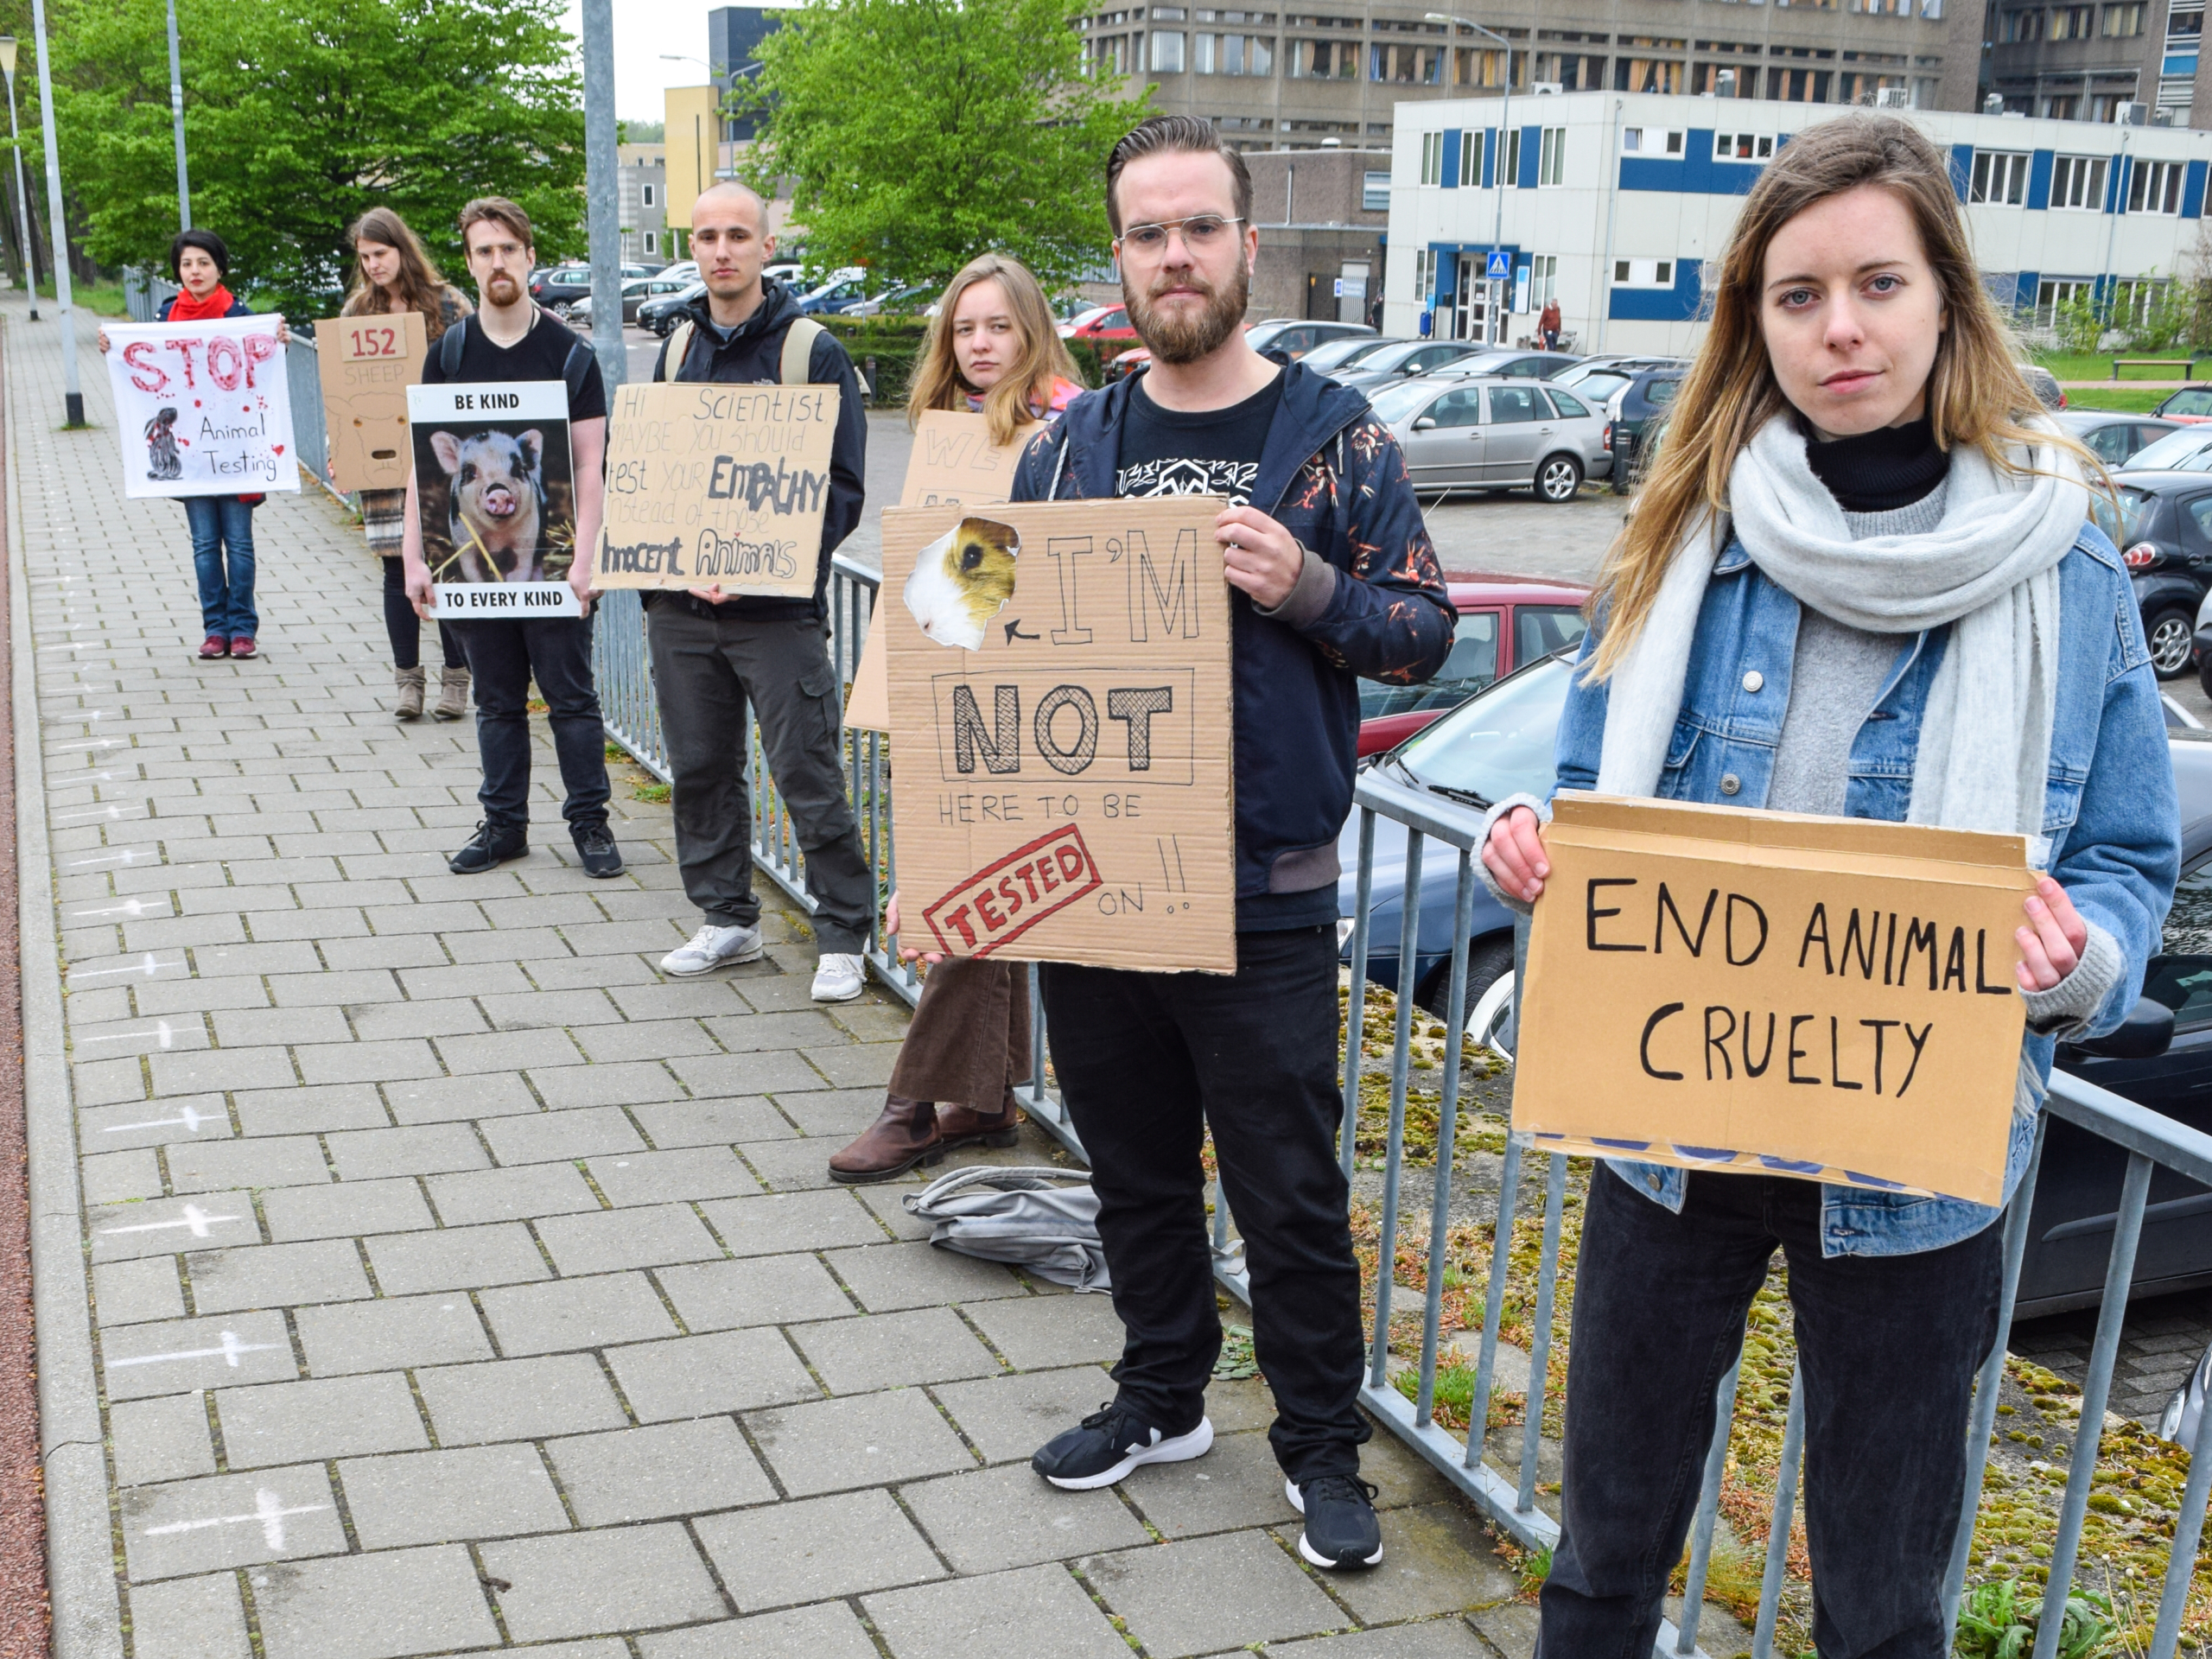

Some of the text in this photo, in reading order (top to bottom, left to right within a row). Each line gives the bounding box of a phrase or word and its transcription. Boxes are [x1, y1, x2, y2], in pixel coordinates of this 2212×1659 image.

[351, 328, 396, 357] 152
[124, 334, 276, 392] STOP
[346, 364, 404, 385] SHEEP
[454, 393, 519, 410] BE KIND
[624, 386, 647, 418] Hi
[200, 413, 265, 440] Animal
[202, 450, 276, 481] Testing
[685, 494, 709, 527] of
[712, 500, 769, 534] those
[445, 591, 563, 607] TO EVERY KIND
[1047, 529, 1199, 645] I'M
[954, 684, 1173, 775] NOT
[939, 792, 1141, 825] HERE TO BE
[944, 844, 1084, 949] TESTED
[1098, 881, 1144, 916] ON
[1587, 878, 2012, 995] END ANIMAL
[1640, 1002, 1933, 1098] CRUELTY
